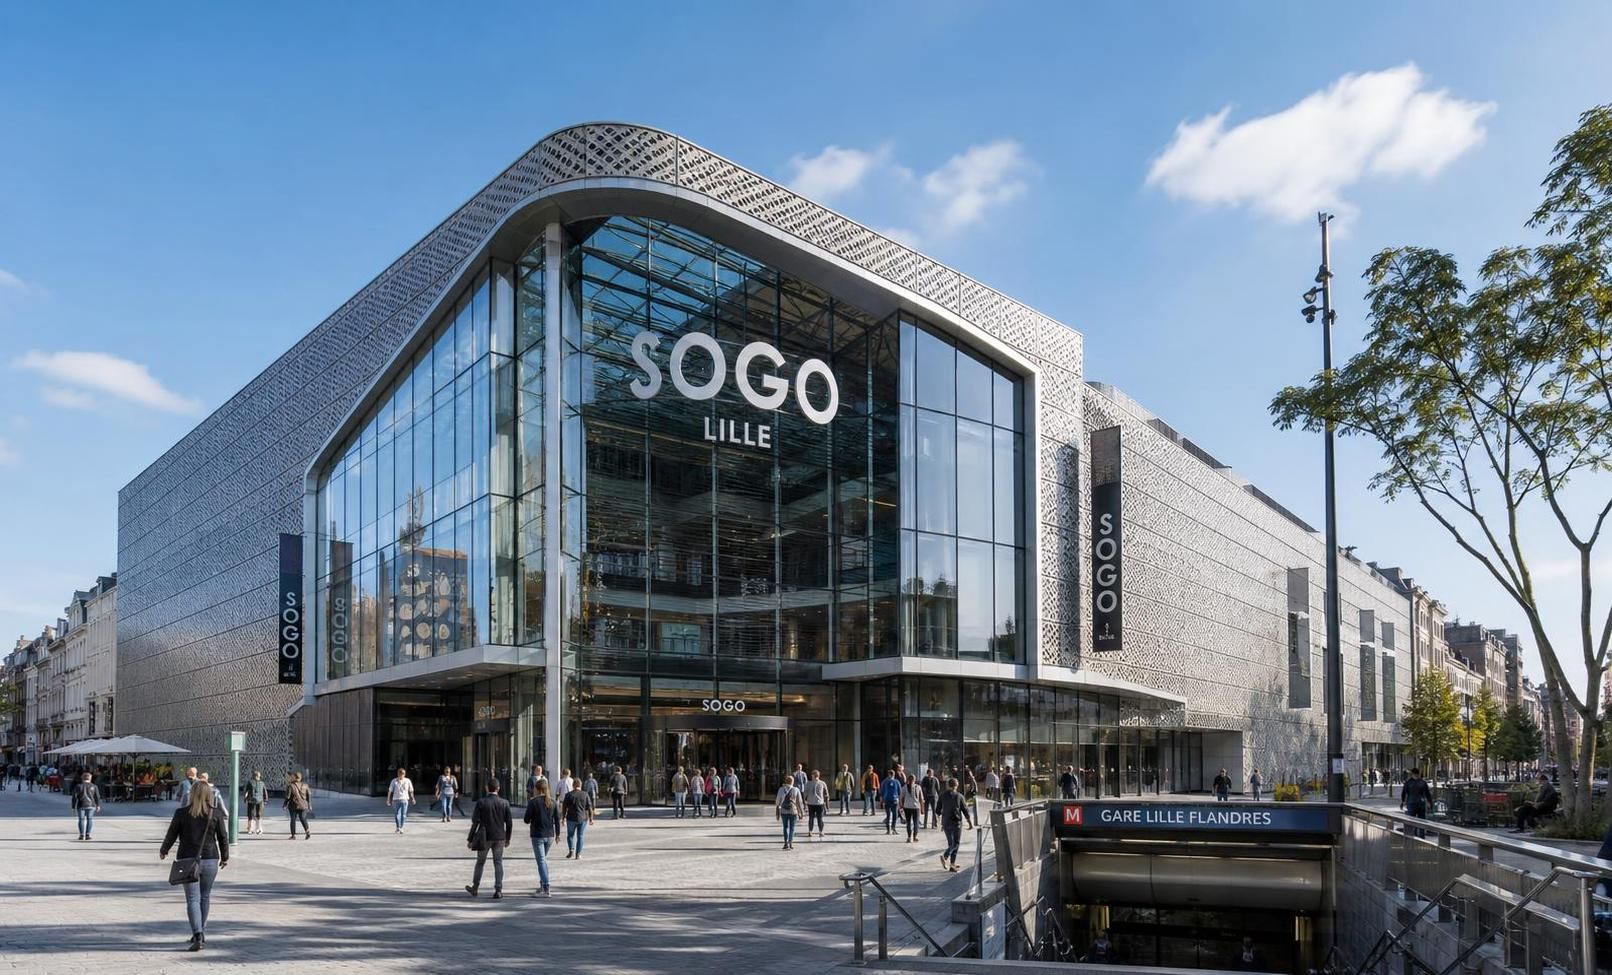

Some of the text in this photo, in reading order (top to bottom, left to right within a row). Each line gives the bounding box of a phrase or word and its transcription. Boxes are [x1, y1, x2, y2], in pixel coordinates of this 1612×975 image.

[630, 331, 839, 425] SOGO
[704, 416, 771, 449] LILLE
[1095, 513, 1117, 613] SOGO
[282, 591, 300, 659] SOGO
[702, 699, 746, 712] SOGO
[1065, 807, 1081, 823] M
[1101, 809, 1272, 825] GARE LILLE FLANDRES
